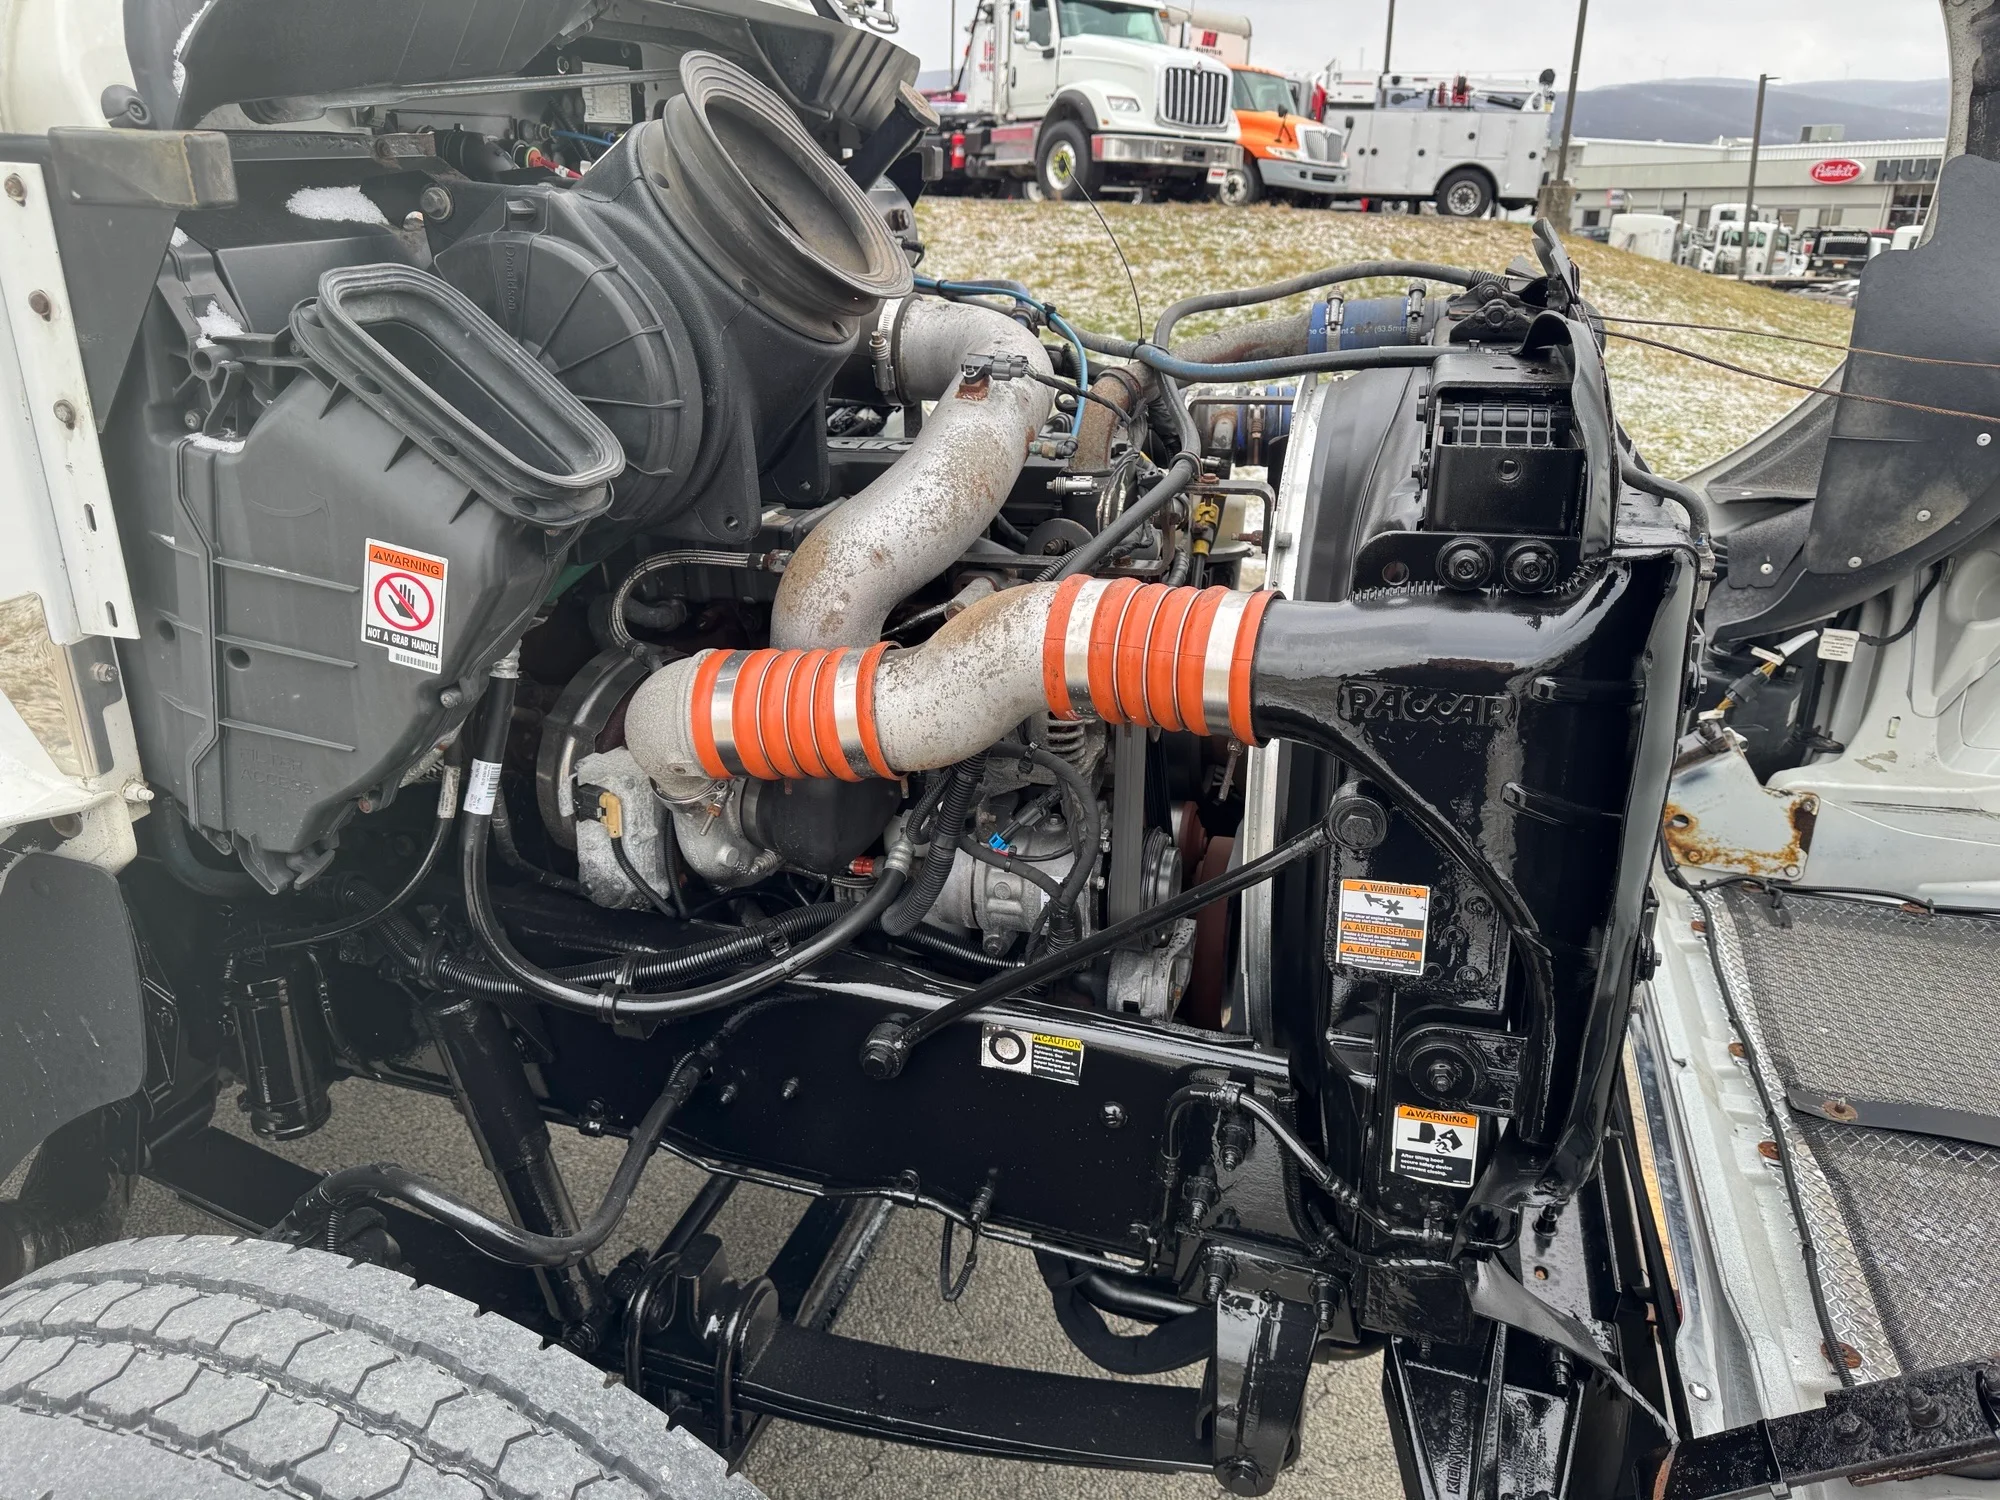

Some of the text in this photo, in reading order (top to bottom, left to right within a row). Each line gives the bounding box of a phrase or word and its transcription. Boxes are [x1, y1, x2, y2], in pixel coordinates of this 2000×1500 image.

[505, 243, 517, 311] Donaldson
[384, 551, 440, 576] WARNING
[367, 626, 437, 655] NOT A GRAB HANDLE
[1339, 684, 1518, 727] PACCAR
[240, 768, 314, 794] ACCESS
[1370, 884, 1411, 895] WARNING
[1354, 923, 1422, 938] AVERTISSEMENT
[1357, 946, 1416, 960] ADVERTENCIA
[1041, 1034, 1081, 1049] CAUTION
[1415, 1110, 1468, 1125] WARNING
